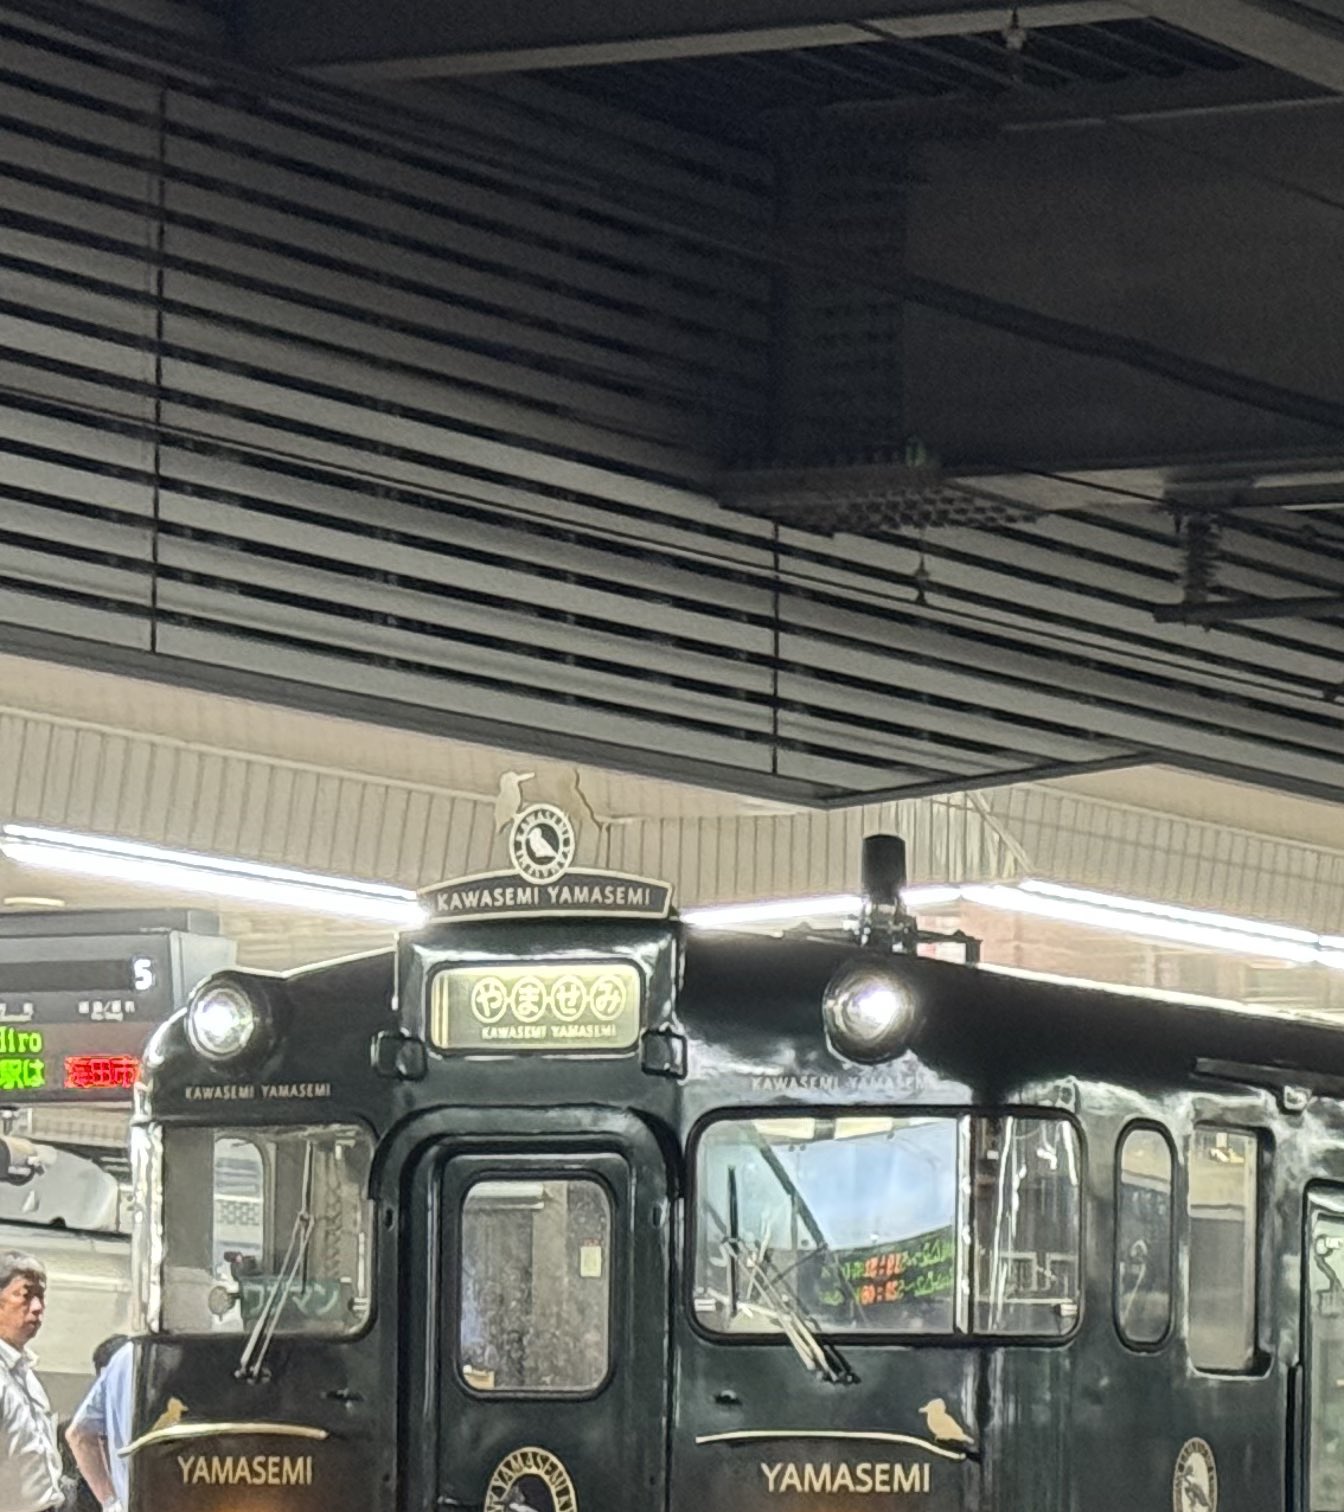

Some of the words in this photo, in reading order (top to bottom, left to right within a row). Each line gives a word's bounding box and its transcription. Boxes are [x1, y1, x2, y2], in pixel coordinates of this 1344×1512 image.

[437, 887, 539, 912] KAWASEMI
[549, 885, 650, 906] YAMASEMI
[133, 958, 151, 990] 5
[475, 979, 622, 1017] やませみ
[481, 1025, 546, 1040] KAWASEMI
[551, 1024, 617, 1039] YAMASEMI
[185, 1085, 254, 1100] KAWASEMI
[261, 1083, 331, 1098] YAMASEMI
[751, 1076, 839, 1090] KAWASEMI
[177, 1455, 313, 1485] YAMASEMI
[489, 1451, 569, 1492] YAMASEMI
[760, 1462, 931, 1493] YAMASEMI
